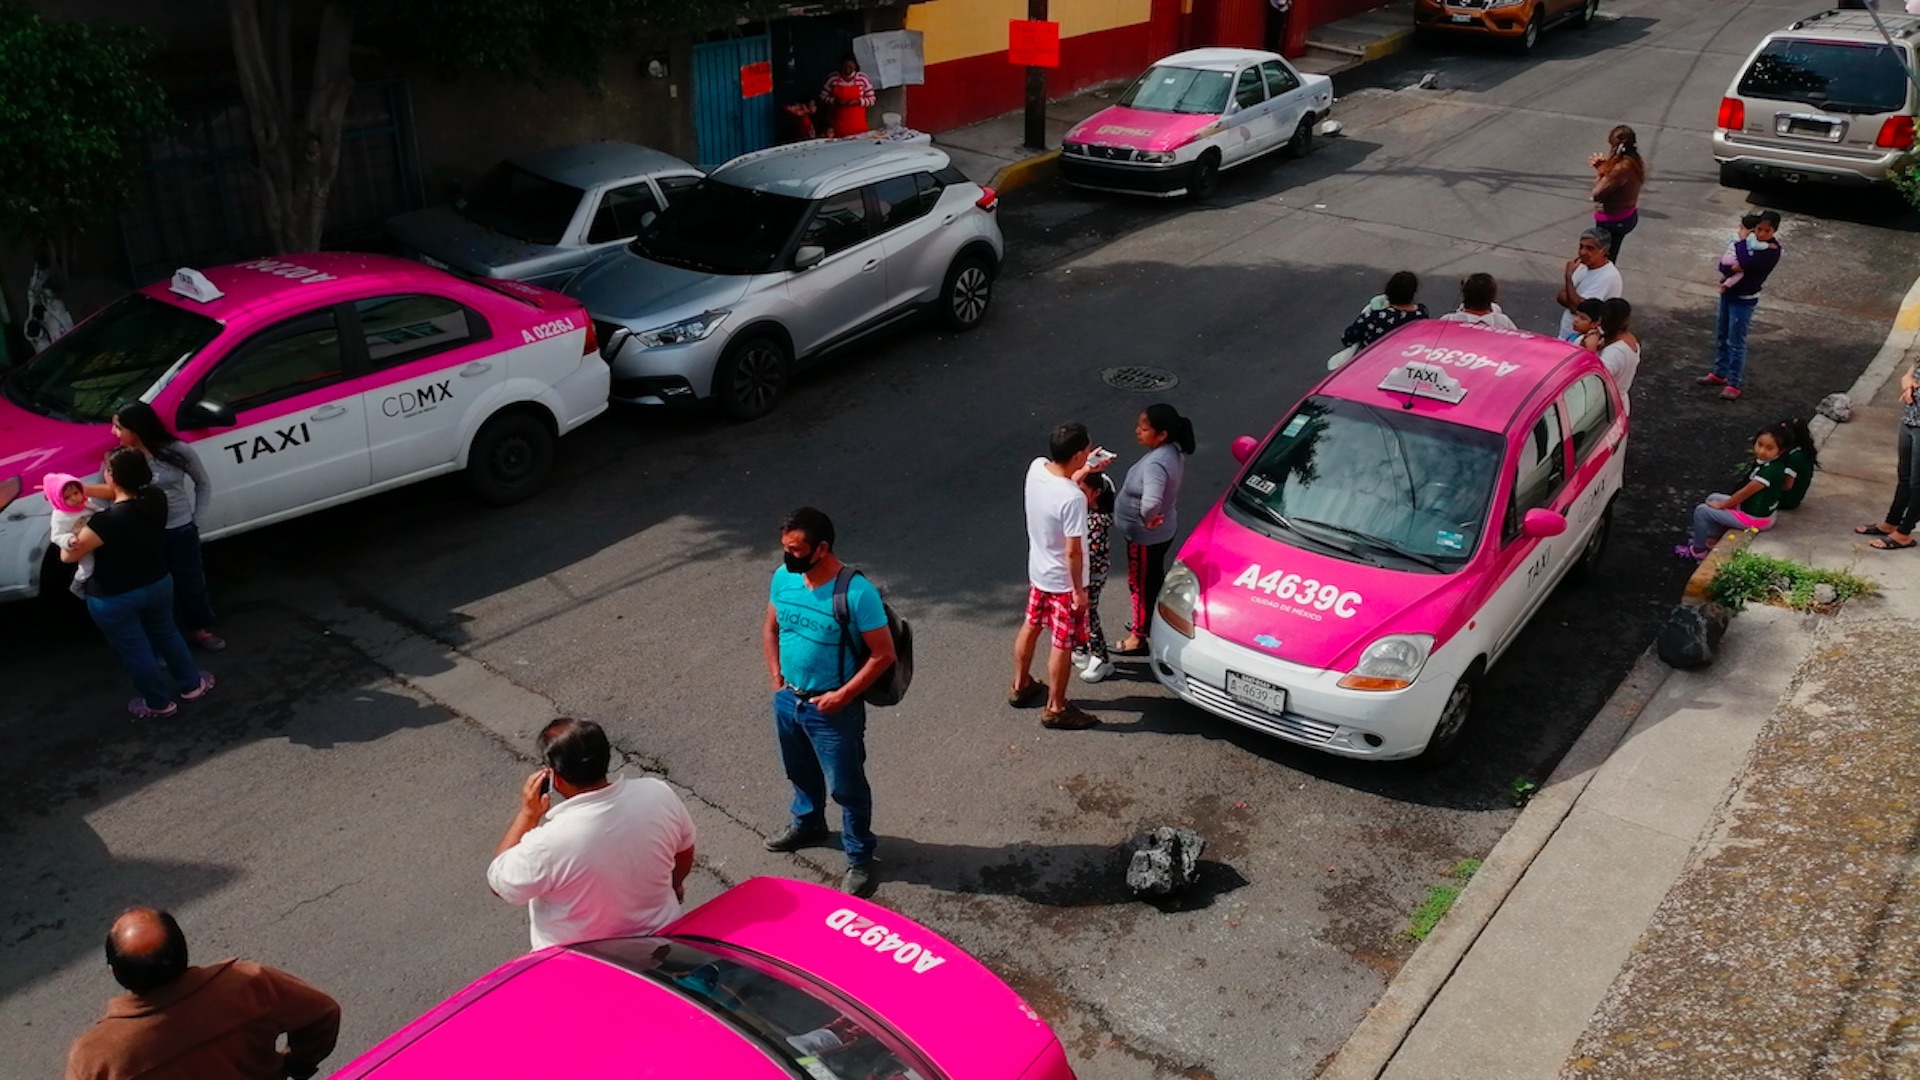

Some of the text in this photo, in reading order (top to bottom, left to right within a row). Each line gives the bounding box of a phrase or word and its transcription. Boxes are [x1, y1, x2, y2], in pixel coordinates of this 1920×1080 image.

[521, 317, 575, 343] A 0226J
[1406, 367, 1438, 383] TAXI
[382, 379, 453, 417] CDMX
[224, 422, 311, 464] TAXI
[1527, 544, 1551, 588] TAXI
[1233, 563, 1362, 618] A4639C
[1250, 596, 1280, 609] CIUDAD
[1280, 603, 1293, 612] DE
[777, 609, 819, 632] didas
[825, 908, 946, 974] A0492D
